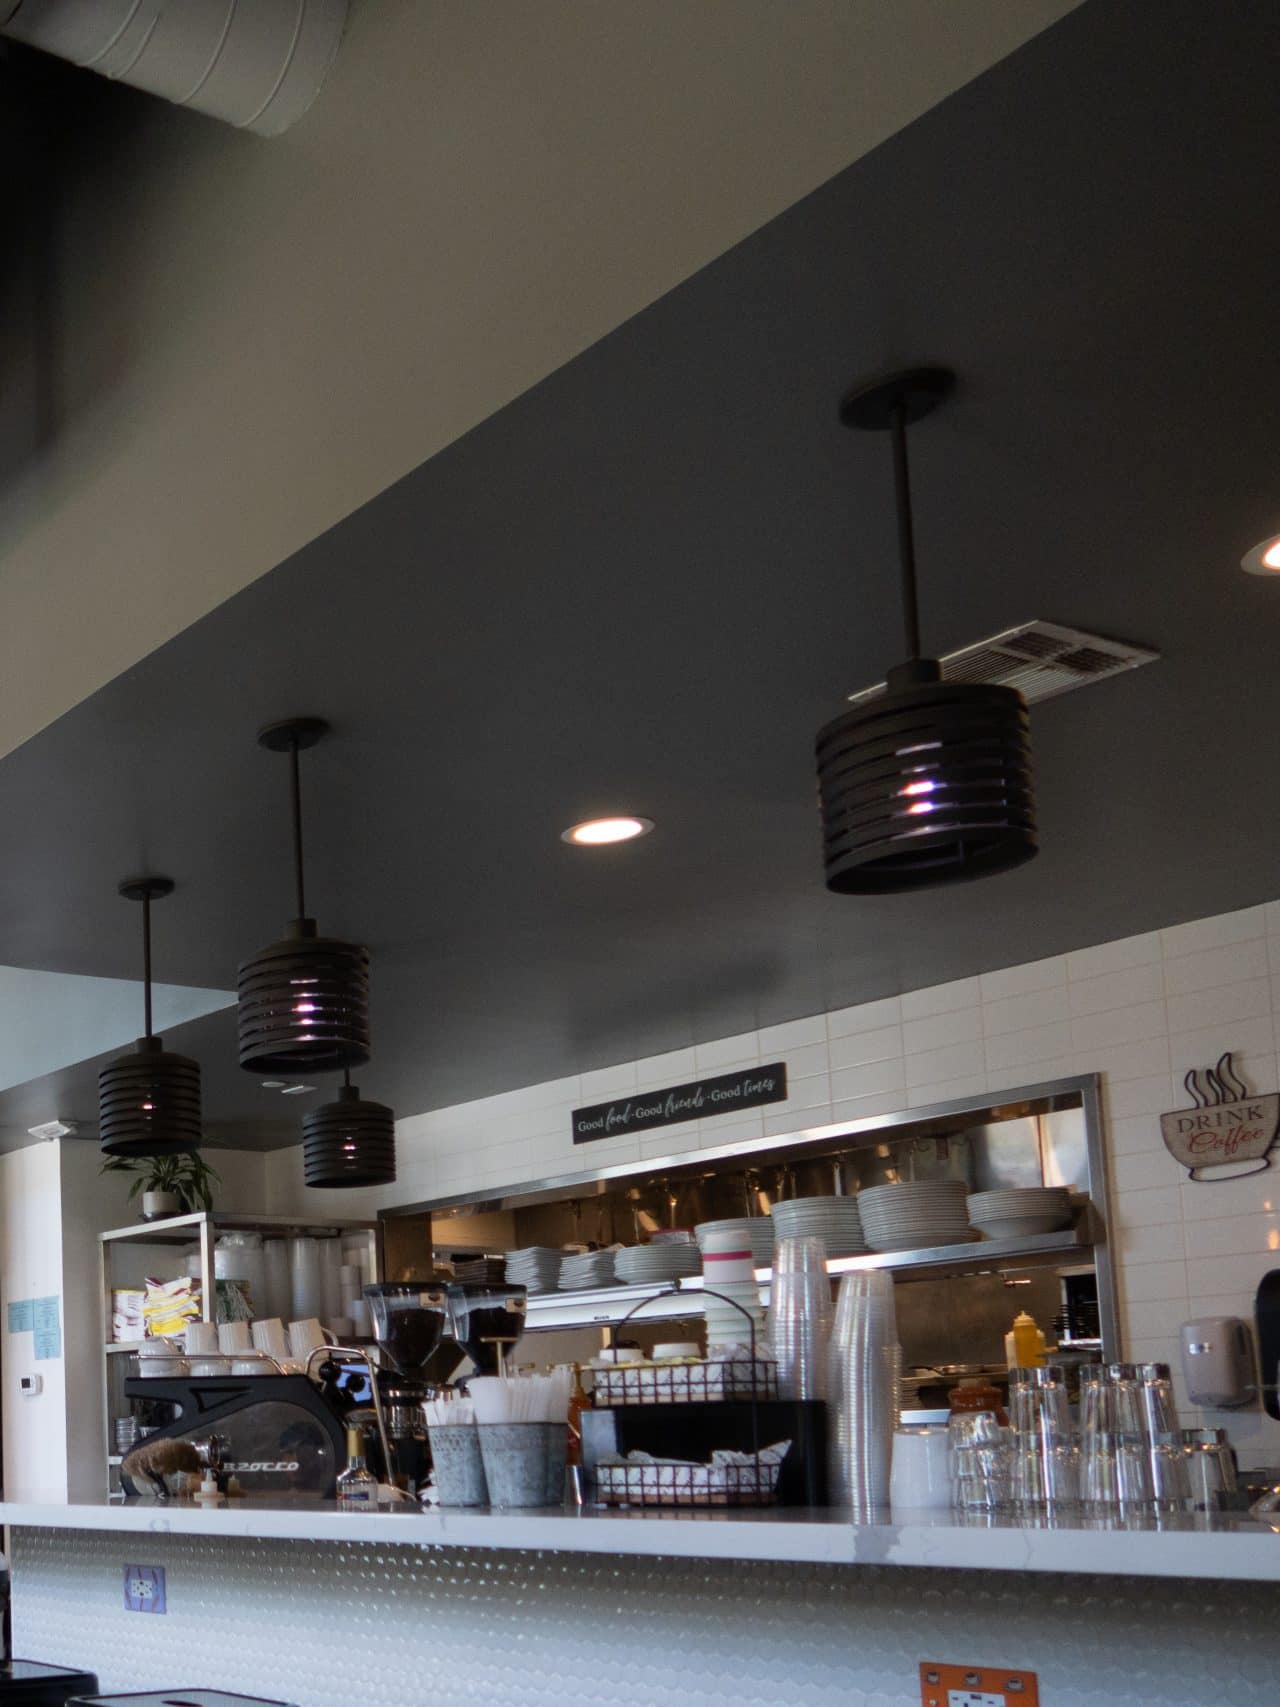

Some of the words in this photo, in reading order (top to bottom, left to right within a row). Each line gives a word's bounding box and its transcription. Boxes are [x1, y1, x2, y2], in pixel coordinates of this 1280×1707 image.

[578, 1116, 604, 1132] Good
[605, 1103, 631, 1133] food
[635, 1103, 662, 1119] Good
[664, 1086, 704, 1118] friends
[711, 1084, 741, 1101] Good
[743, 1078, 776, 1096] times
[1176, 1105, 1264, 1133] DRINK
[1187, 1124, 1264, 1156] Coffee
